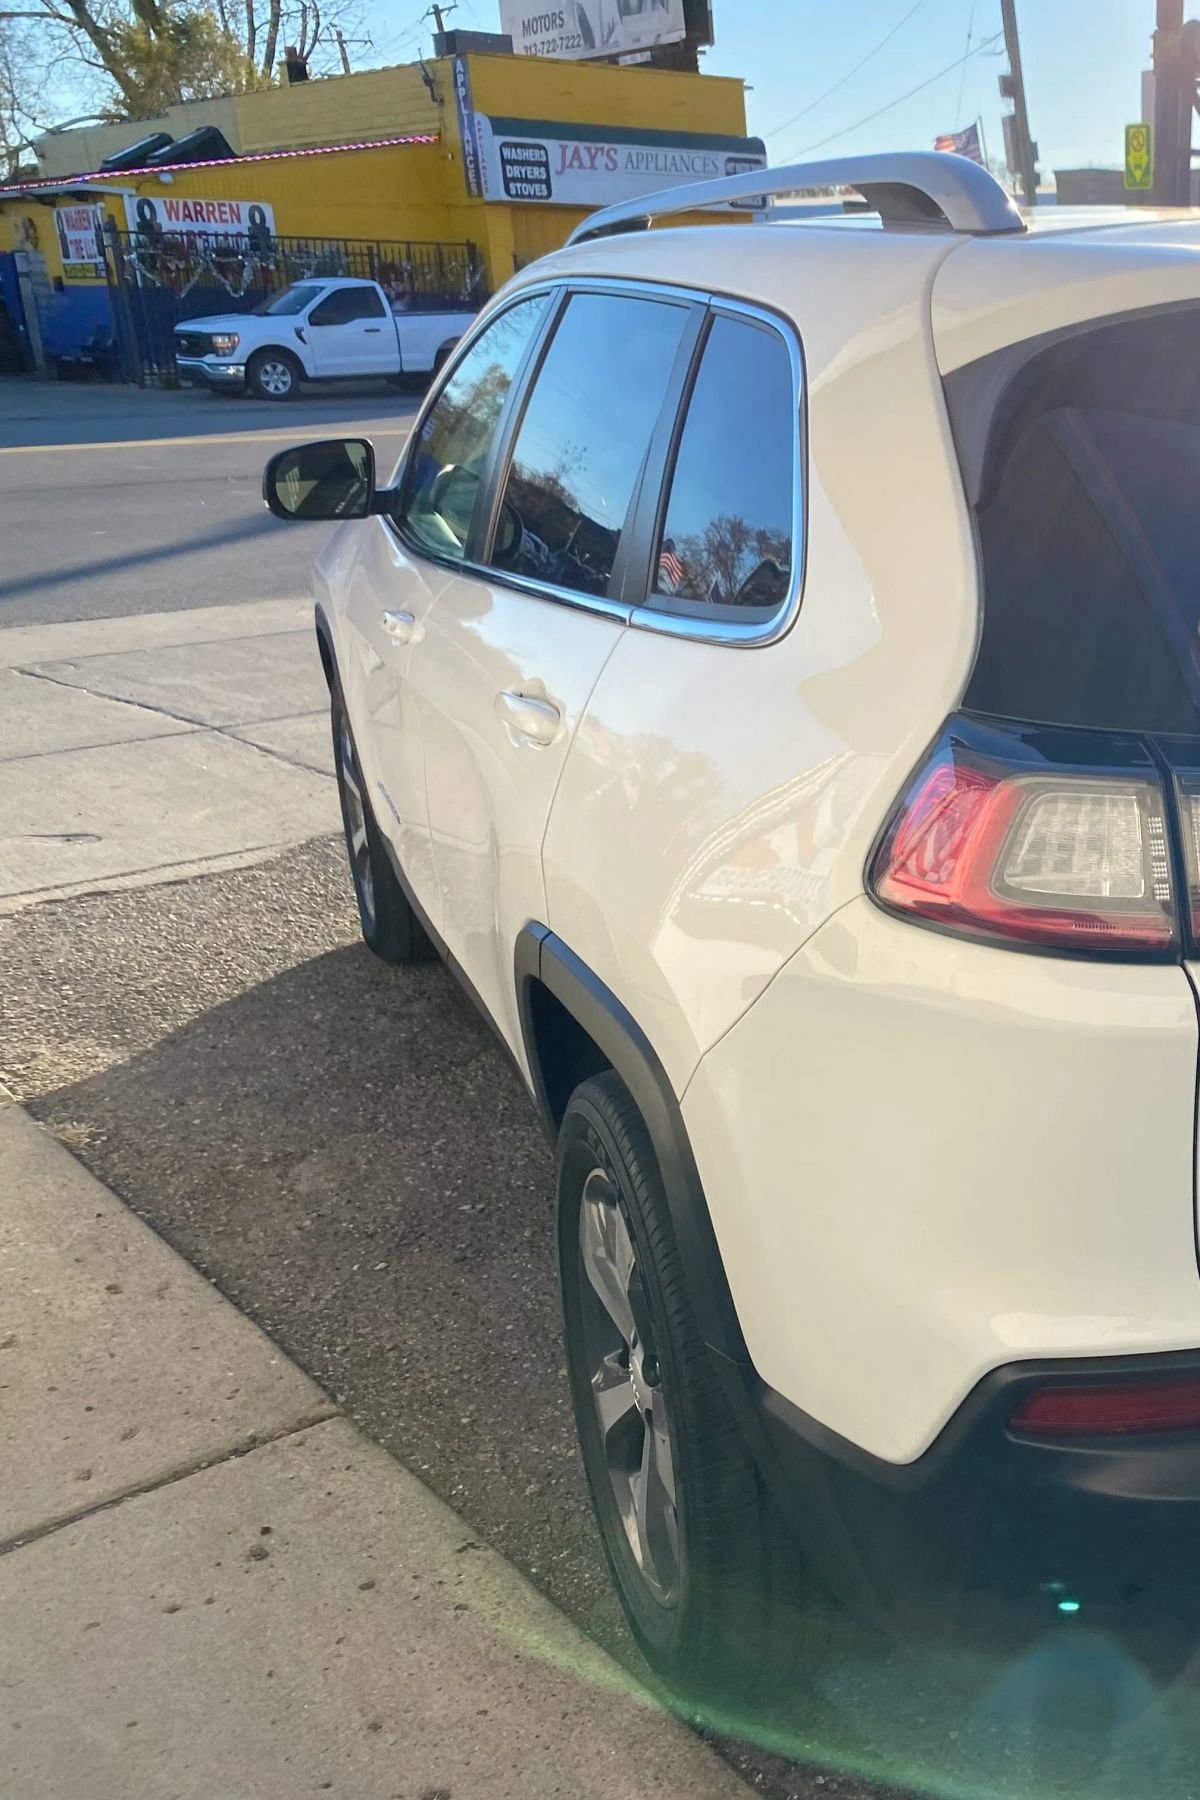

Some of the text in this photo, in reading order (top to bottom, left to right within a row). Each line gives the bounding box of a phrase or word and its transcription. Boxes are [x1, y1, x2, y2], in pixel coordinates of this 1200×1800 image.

[522, 11, 564, 38] MOTORS
[456, 59, 478, 197] APPLIANCES
[502, 147, 546, 162] WASHERS
[555, 144, 618, 176] JAY'S
[624, 151, 719, 175] APPLIANCES
[506, 165, 546, 180] DRYERS
[509, 182, 548, 196] STOVES
[163, 199, 242, 224] WARREN
